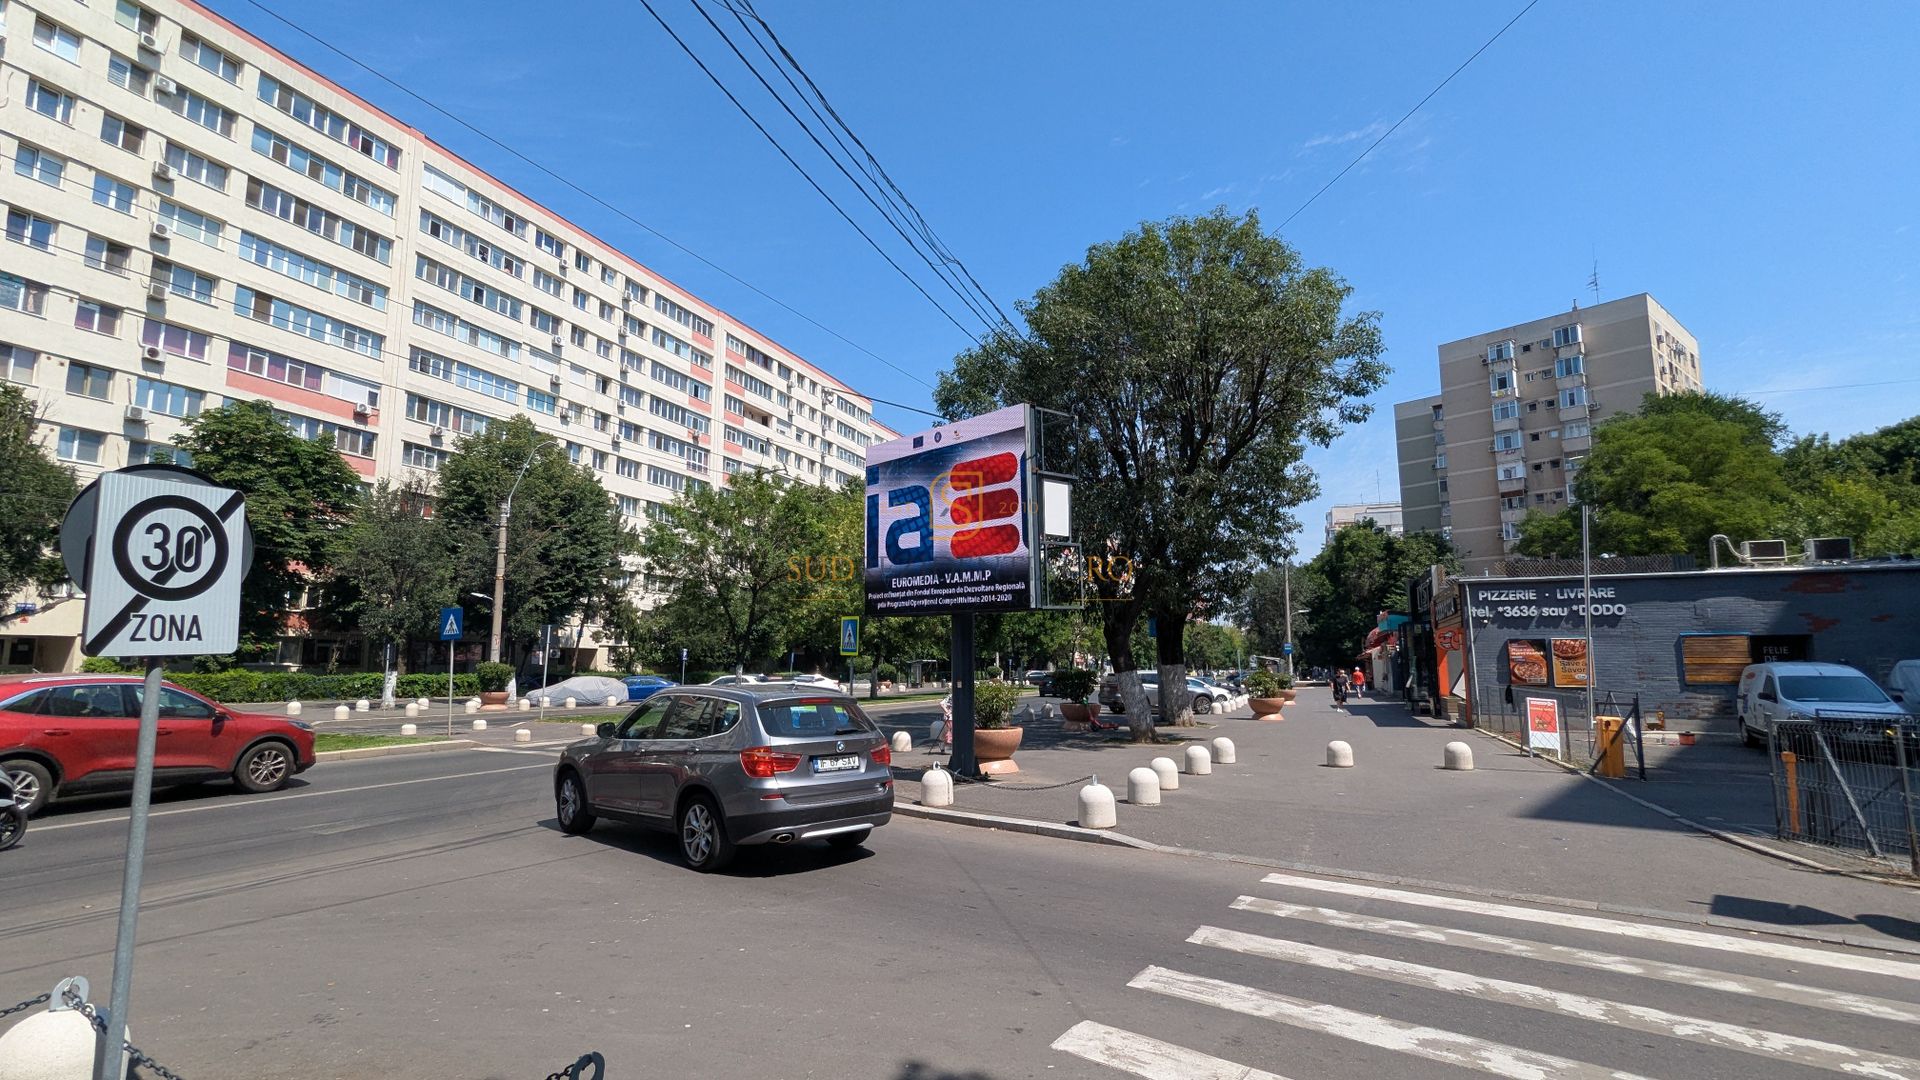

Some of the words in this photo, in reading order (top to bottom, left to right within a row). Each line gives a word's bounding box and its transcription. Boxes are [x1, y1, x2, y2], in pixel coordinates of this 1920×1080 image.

[142, 522, 204, 573] 30
[891, 573, 939, 589] EUROMEDIA
[945, 569, 992, 584] V.A.M.M.P
[981, 593, 1013, 603] 2014-2020
[1478, 588, 1537, 601] PIZZERIE
[1556, 587, 1616, 600] LIVRARE
[1471, 605, 1493, 618] tel.
[1541, 605, 1568, 617] sau
[129, 613, 203, 642] ZONA
